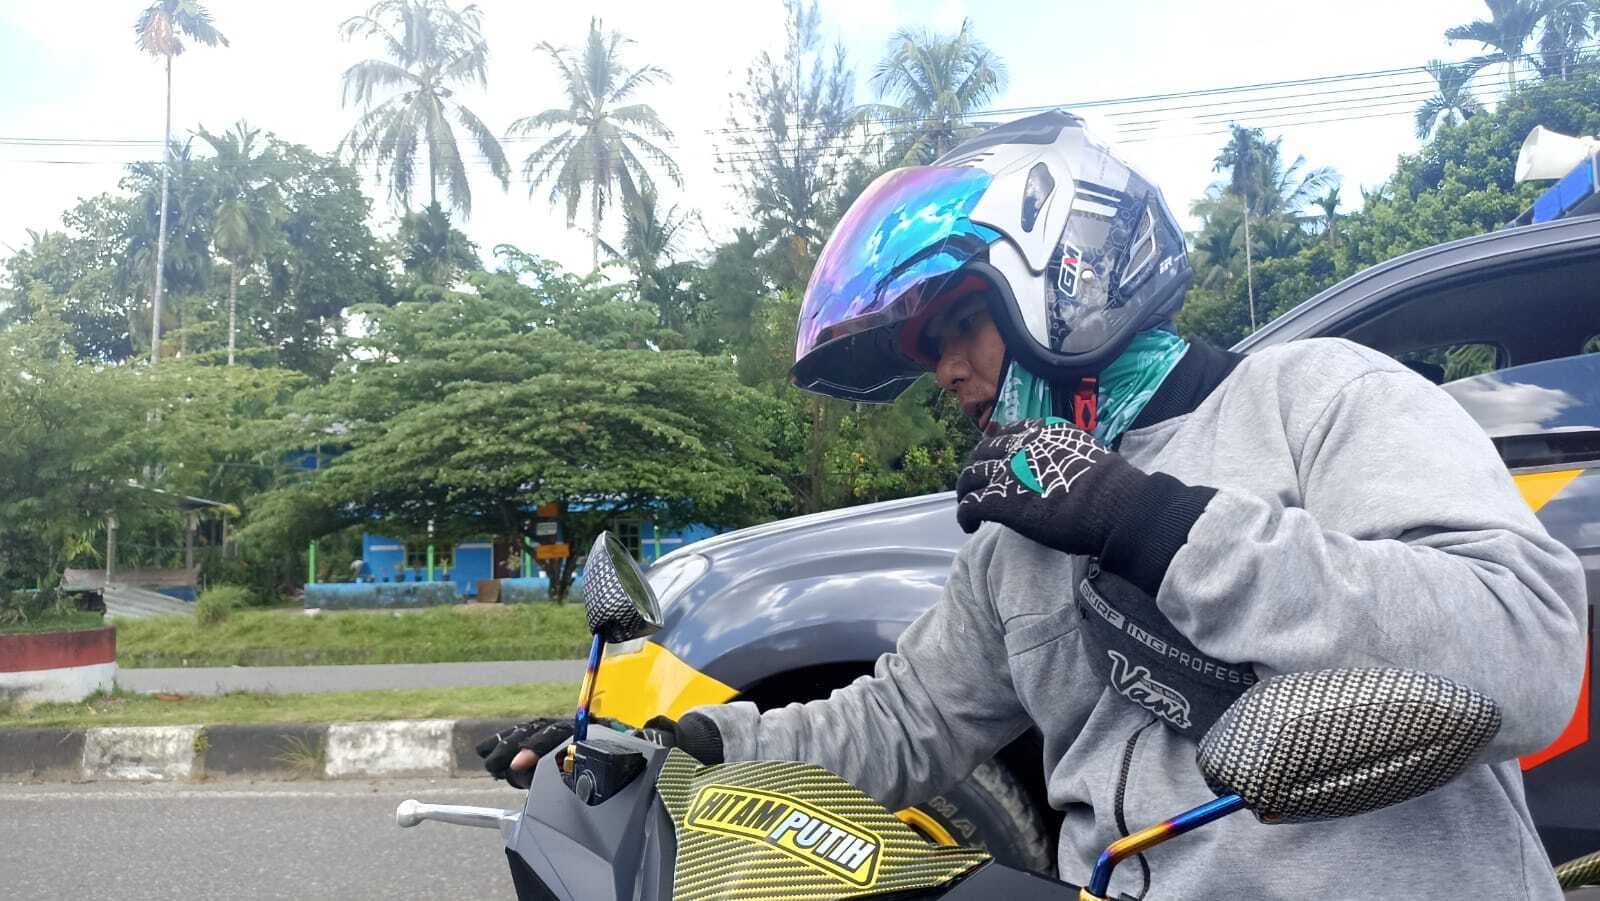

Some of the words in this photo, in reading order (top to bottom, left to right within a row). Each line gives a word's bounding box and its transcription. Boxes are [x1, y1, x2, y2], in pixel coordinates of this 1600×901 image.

[1081, 581, 1122, 627] SURF
[1127, 623, 1167, 655] ING
[700, 791, 787, 832] HITAM
[769, 809, 877, 871] PUTIH
